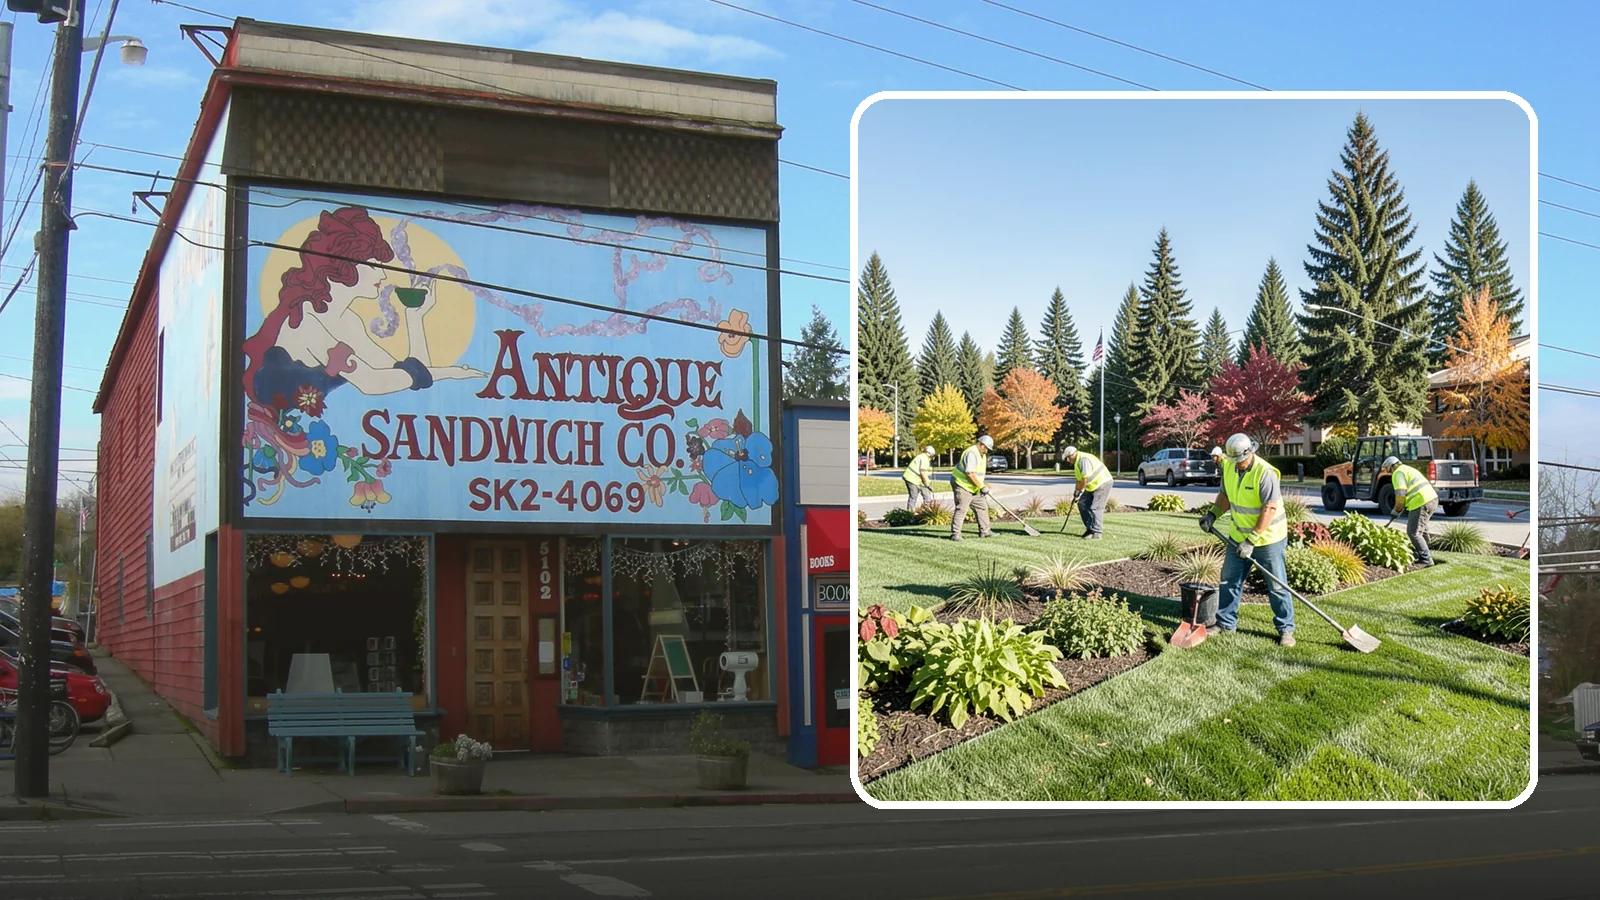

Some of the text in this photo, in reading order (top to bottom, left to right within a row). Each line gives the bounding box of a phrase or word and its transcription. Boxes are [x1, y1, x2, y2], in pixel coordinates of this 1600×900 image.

[475, 330, 722, 420] ANTIQUE
[362, 409, 684, 467] SANDWICH CO.
[469, 478, 645, 512] SK2-4069
[539, 542, 551, 599] 5102
[810, 555, 834, 568] BOOKS
